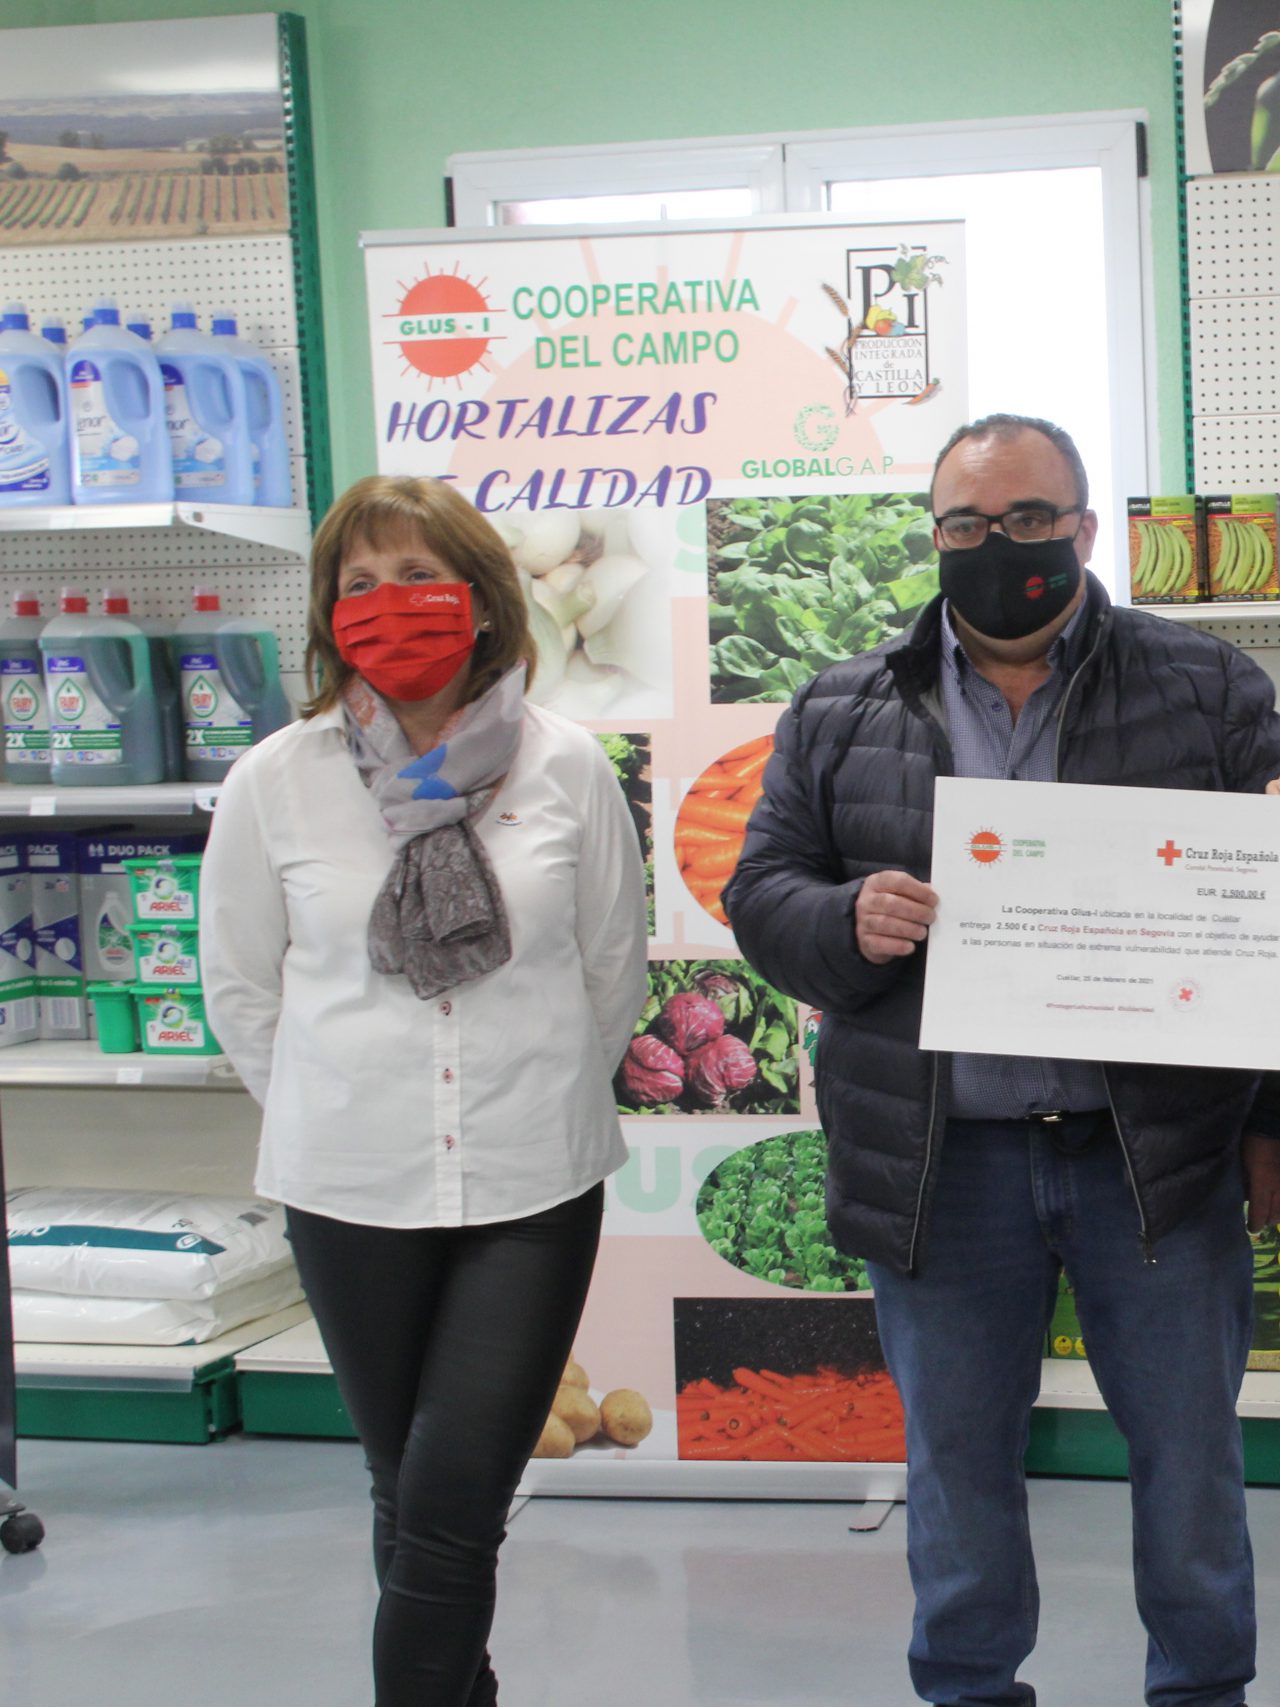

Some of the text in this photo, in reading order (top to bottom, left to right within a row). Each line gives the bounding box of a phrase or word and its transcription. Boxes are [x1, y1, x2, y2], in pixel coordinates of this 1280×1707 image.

[512, 278, 760, 320] COOPERATIVA
[399, 318, 456, 336] GLUS
[535, 329, 740, 369] DEL CAMPO
[854, 369, 923, 382] CASTILLA
[386, 391, 717, 443] HORTALIZAS
[474, 465, 712, 514] CALIDAD
[6, 732, 26, 748] 2X
[53, 732, 73, 748] 2X
[186, 729, 206, 745] 2X
[1185, 847, 1279, 864] Cruz Roja Española
[1001, 905, 1013, 914] La
[1015, 906, 1068, 917] Cooperativa
[959, 921, 991, 931] entrega
[996, 922, 1020, 931] 2.500
[1022, 923, 1028, 931] €
[1037, 923, 1058, 932] Cruz
[1060, 924, 1080, 935] Roja
[1082, 925, 1124, 936] Española
[1139, 927, 1175, 938] Segovia
